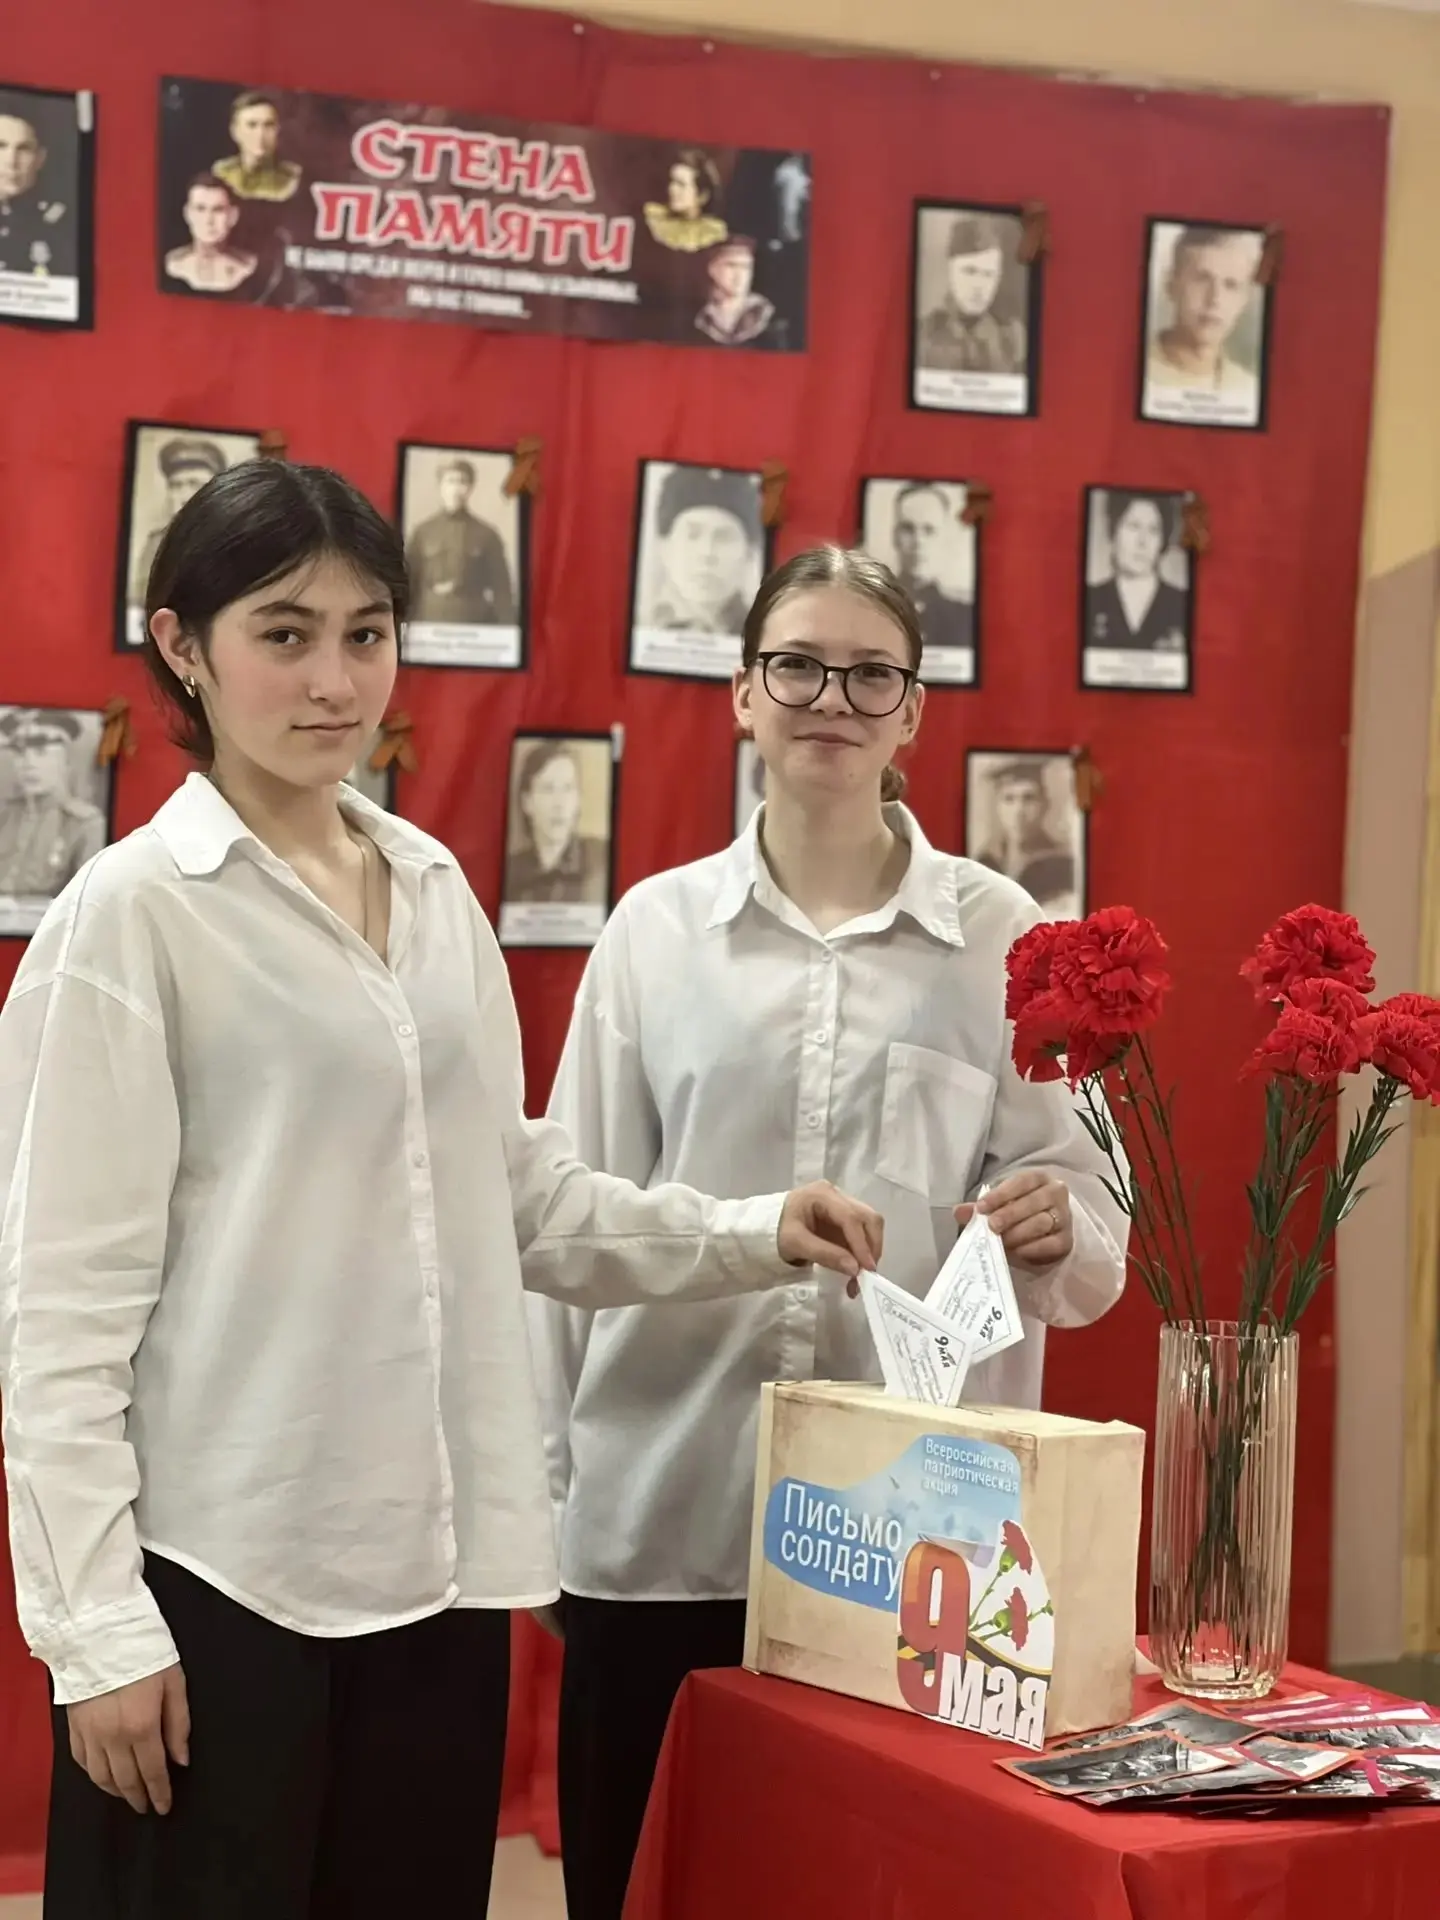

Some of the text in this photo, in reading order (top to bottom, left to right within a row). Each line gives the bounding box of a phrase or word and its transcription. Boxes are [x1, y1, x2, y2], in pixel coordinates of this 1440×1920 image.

[352, 119, 595, 201] СТЕНА
[311, 182, 635, 272] ПАМЯТИ
[992, 1305, 1003, 1321] 9
[934, 1336, 949, 1346] 9
[924, 1459, 1020, 1495] патриотическая
[926, 1438, 1015, 1474] Всероссийская
[922, 1477, 958, 1496] акция
[784, 1483, 902, 1552] Письмо
[781, 1530, 902, 1601] солдату
[897, 1541, 971, 1717] 9
